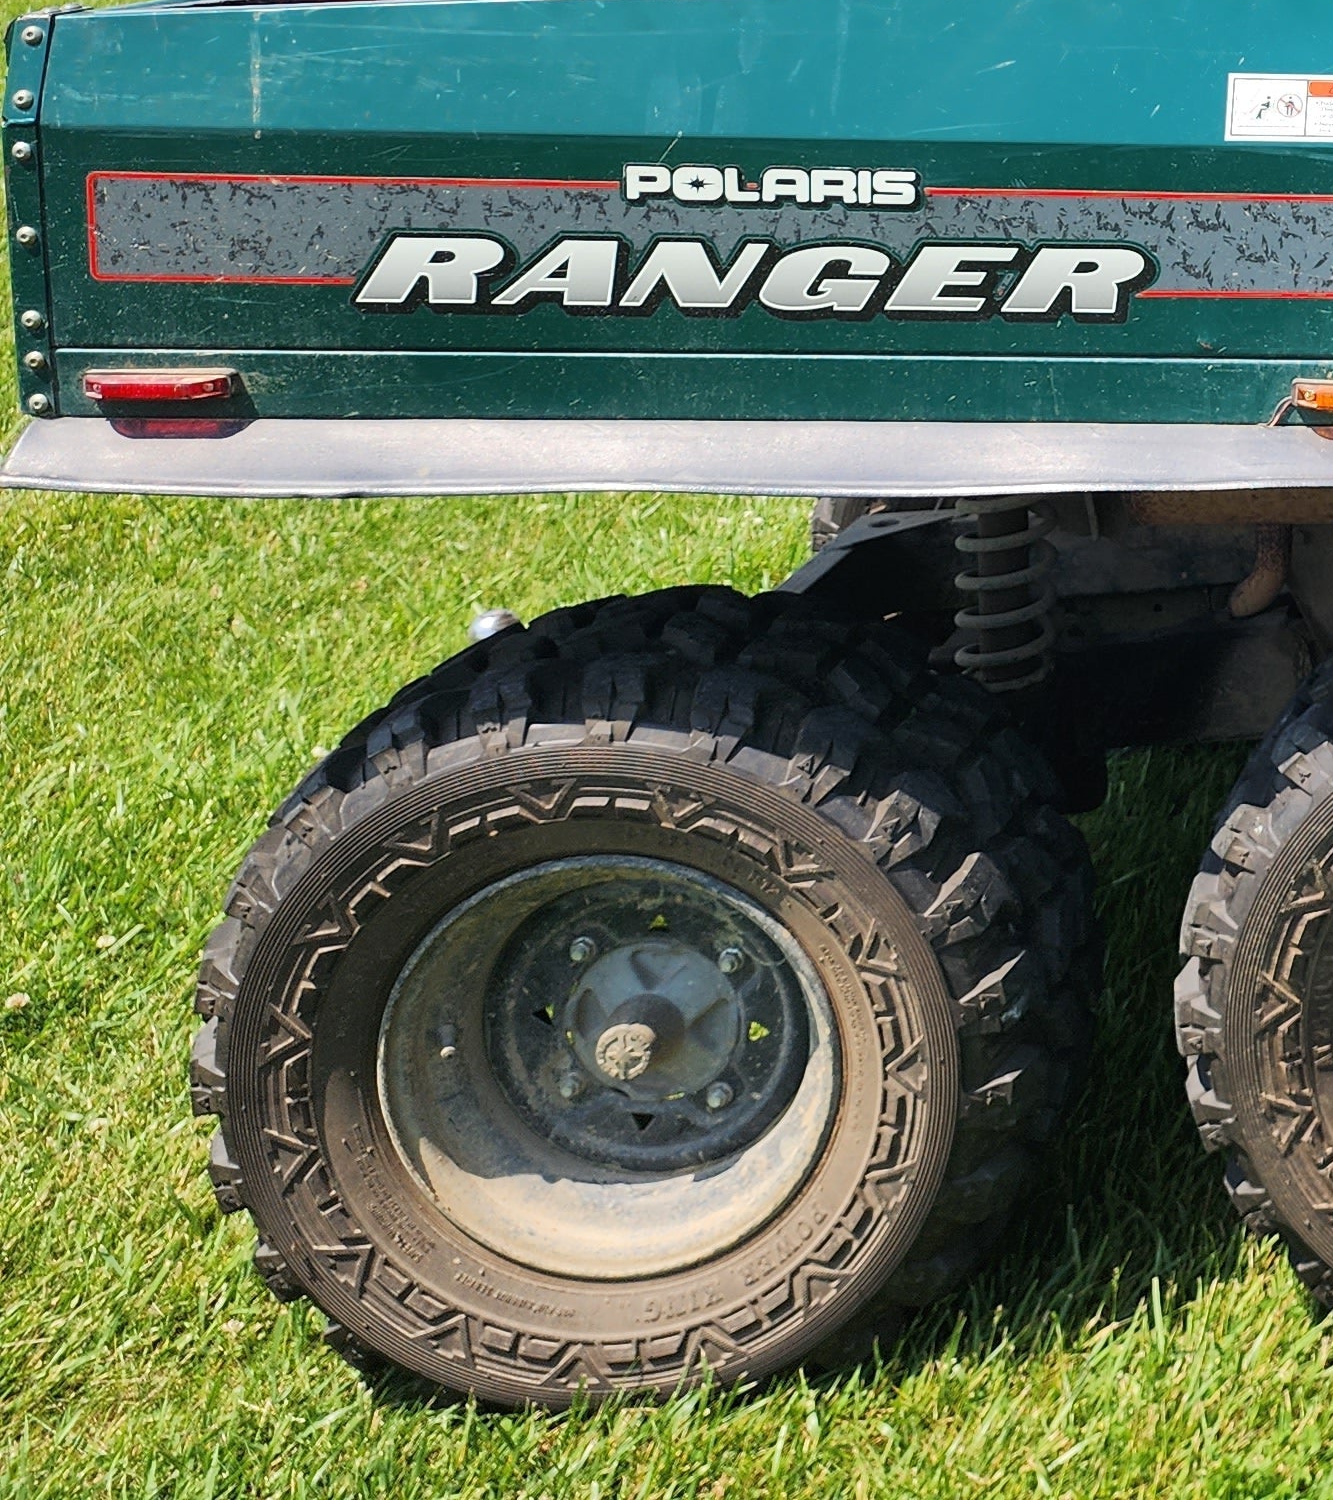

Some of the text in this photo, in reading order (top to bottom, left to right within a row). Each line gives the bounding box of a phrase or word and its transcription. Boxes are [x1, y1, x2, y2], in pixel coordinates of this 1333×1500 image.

[626, 164, 917, 205] POLARIS
[354, 235, 1146, 314] RANGER
[737, 1202, 828, 1287] POWER
[642, 1280, 724, 1324] KING
